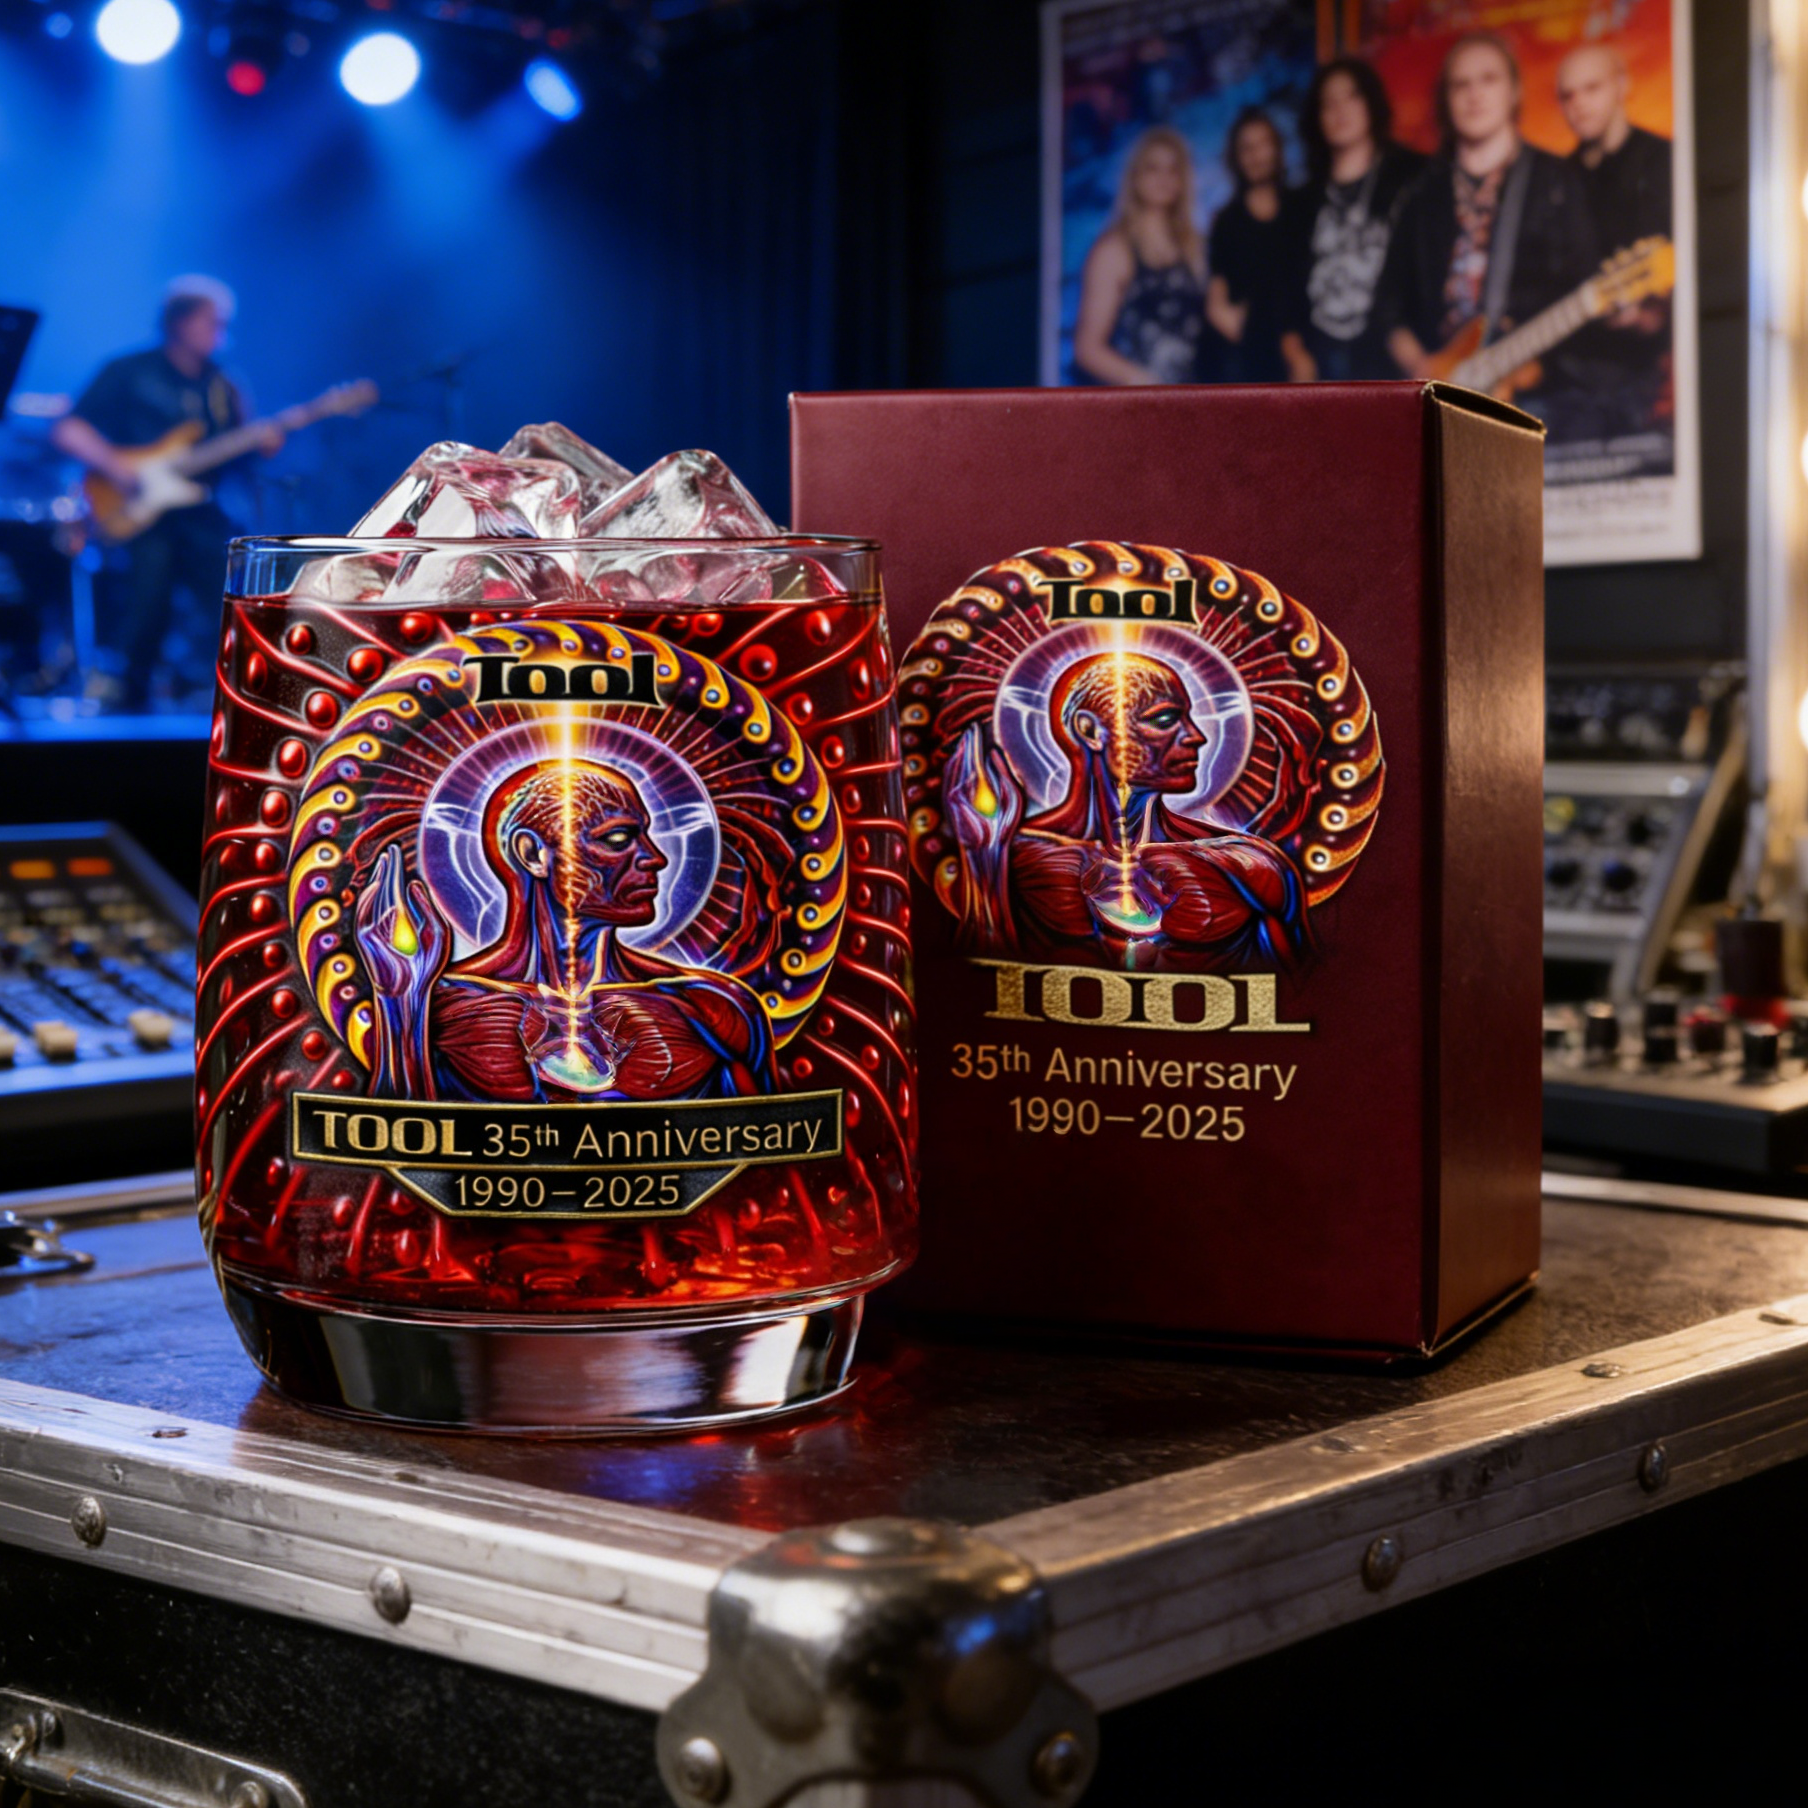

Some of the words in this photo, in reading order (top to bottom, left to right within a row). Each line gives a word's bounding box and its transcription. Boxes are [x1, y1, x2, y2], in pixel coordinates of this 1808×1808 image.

[950, 1043, 1031, 1081] 35th
[1044, 1047, 1298, 1101] Anniversary
[312, 1110, 473, 1157] TOOL
[482, 1123, 559, 1158] 35th
[573, 1118, 822, 1160] Anniversary
